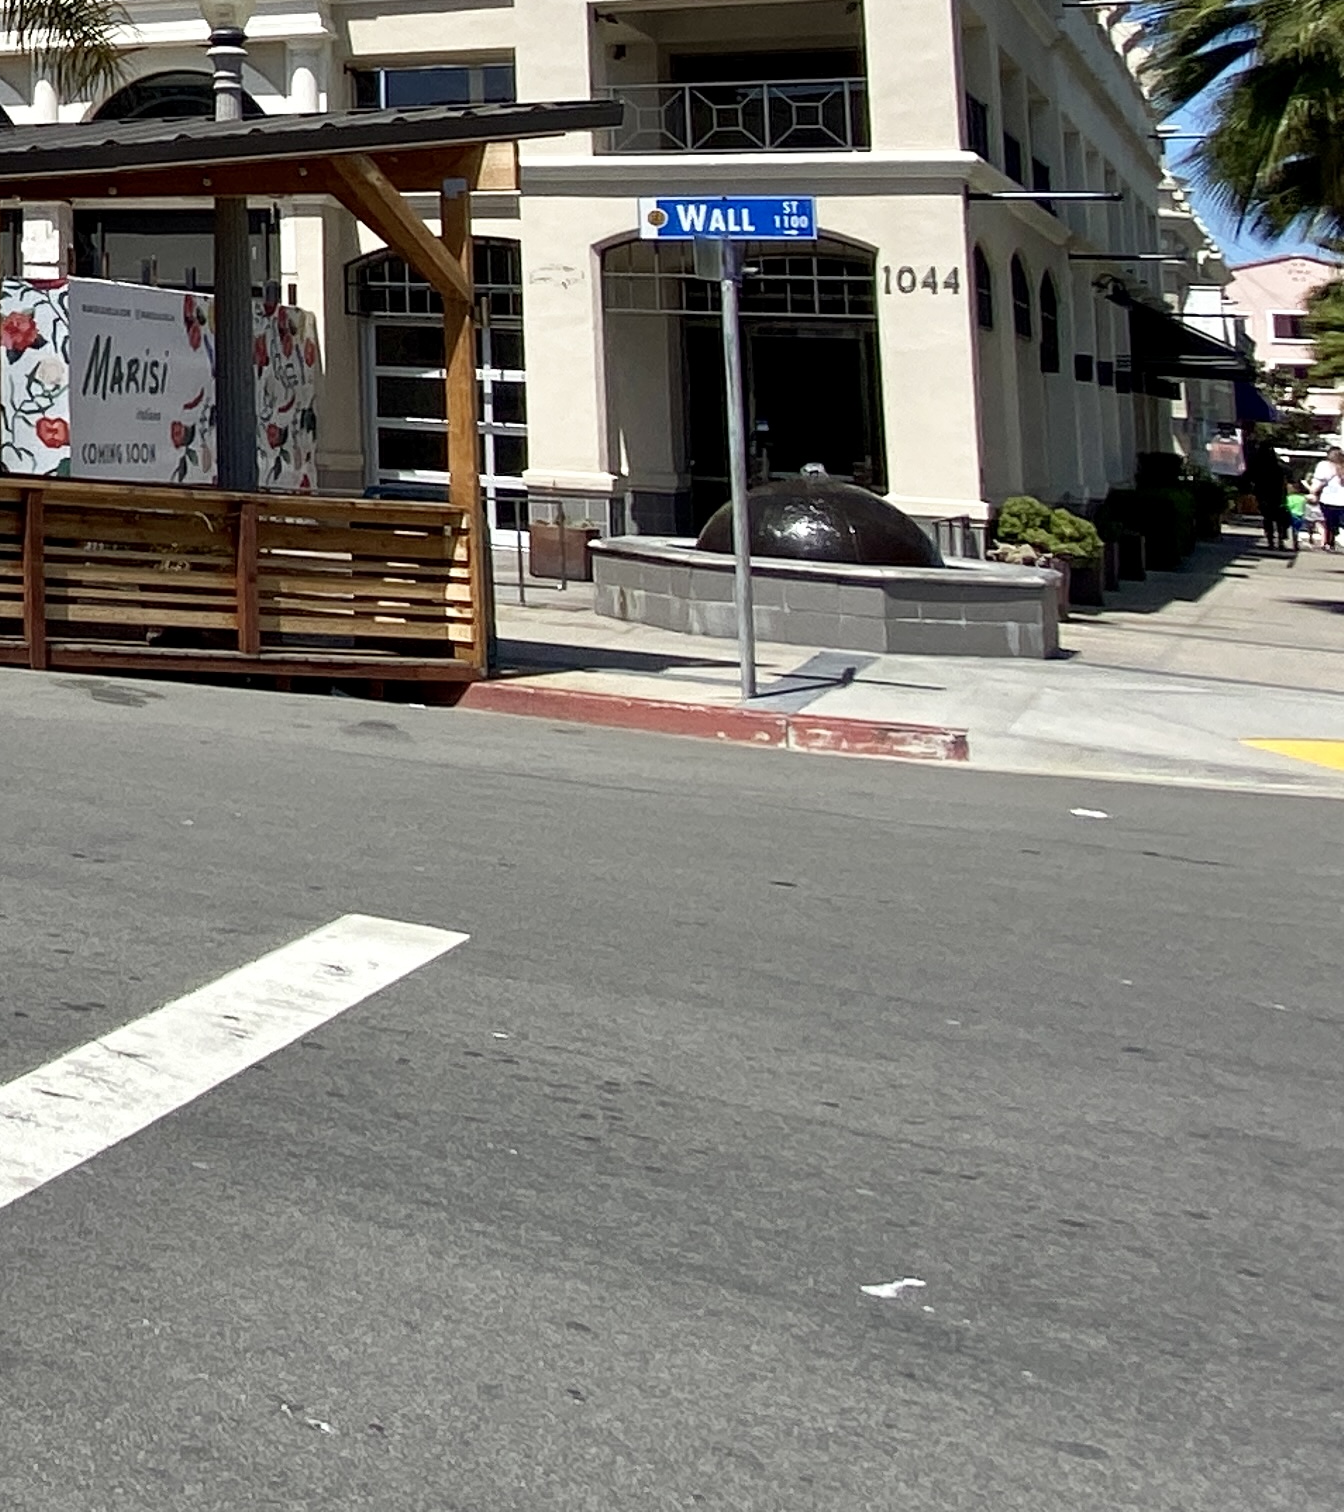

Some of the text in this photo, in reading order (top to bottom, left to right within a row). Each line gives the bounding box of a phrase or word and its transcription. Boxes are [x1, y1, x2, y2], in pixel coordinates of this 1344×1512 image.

[676, 204, 755, 232] WALL
[782, 201, 799, 214] ST
[774, 215, 809, 229] 1100
[882, 265, 960, 295] 1044
[82, 443, 156, 465] COMING SOON
